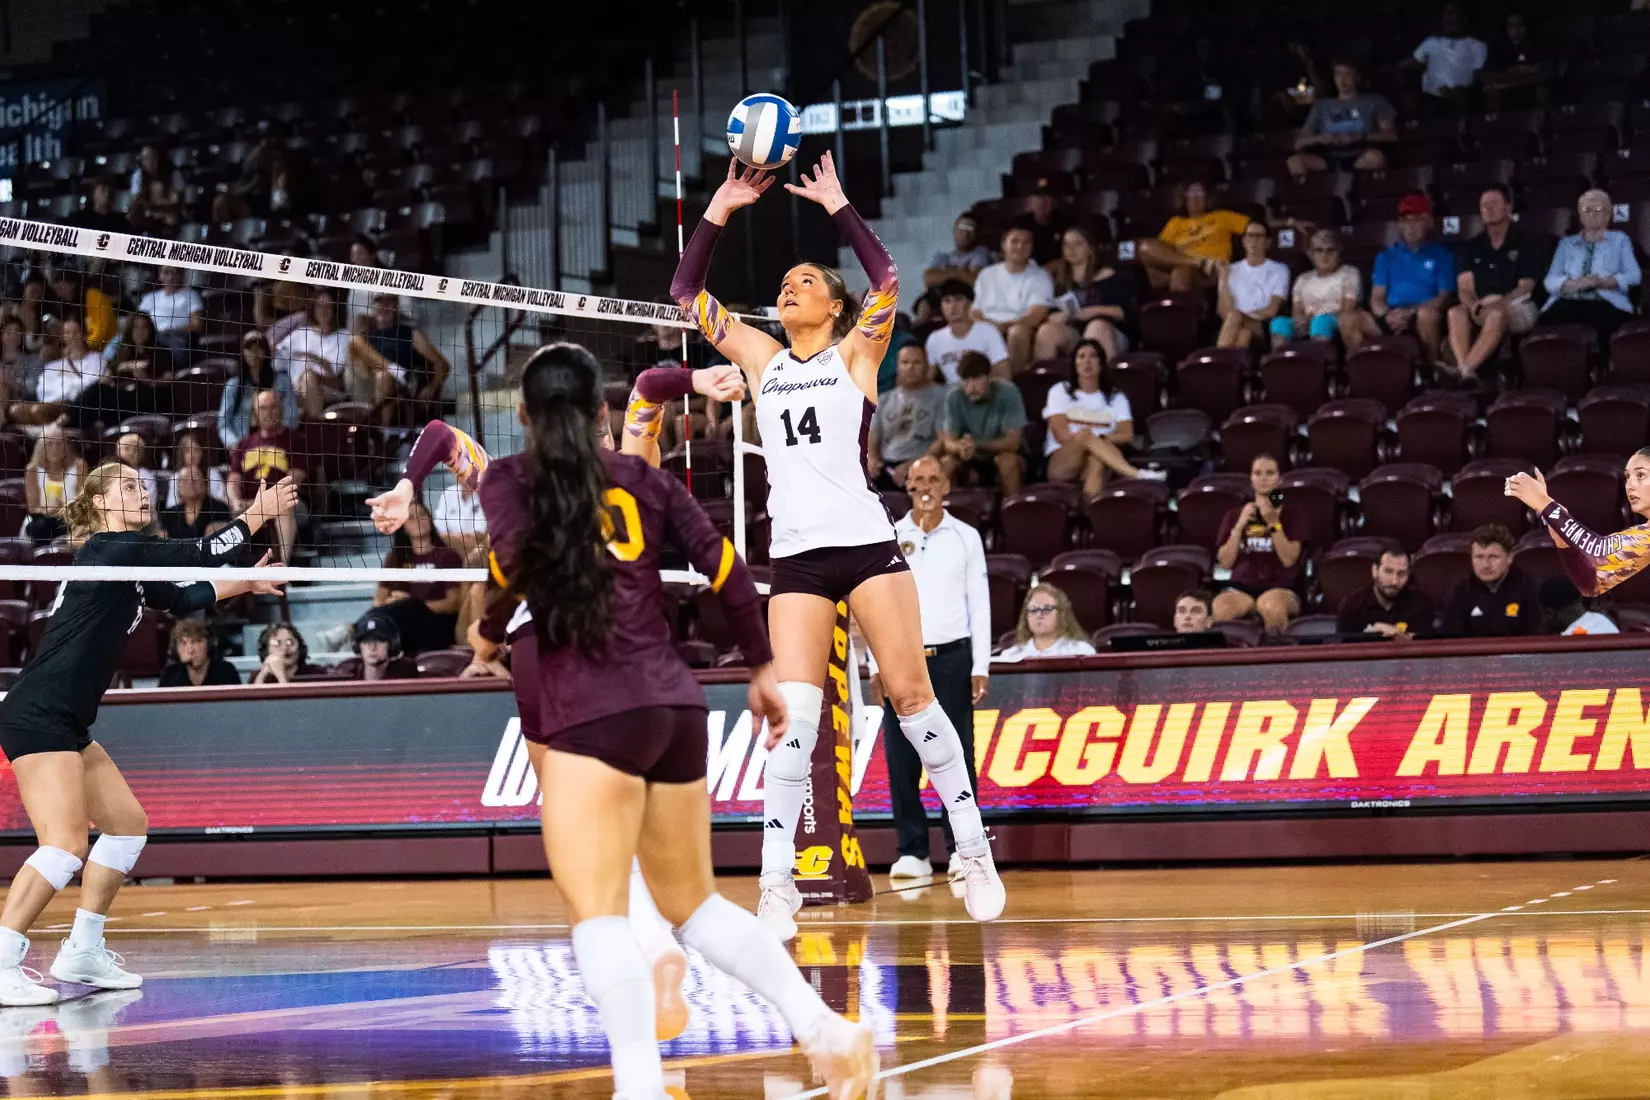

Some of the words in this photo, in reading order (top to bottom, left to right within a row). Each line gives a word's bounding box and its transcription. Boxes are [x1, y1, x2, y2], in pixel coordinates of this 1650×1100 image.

[20, 222, 79, 247] VOLLEYBALL
[127, 237, 166, 257] CENTRAL
[168, 243, 212, 263] MICHIGAN
[212, 249, 263, 271] VOLLEYBALL
[305, 261, 339, 281] CENTRAL
[341, 266, 380, 285] MICHIGAN
[380, 270, 424, 291] VOLLEYBALL
[461, 281, 490, 299] CENTRAL
[492, 284, 526, 303] MICHIGAN
[526, 290, 564, 309] VOLLEYBALL
[597, 299, 624, 315] CENTRAL
[625, 301, 655, 318] MICHIGAN
[762, 377, 838, 395] Chippewas
[780, 406, 822, 447] 14
[595, 486, 645, 561] 0
[1560, 518, 1622, 557] CHIPPEWAS
[1395, 687, 1650, 777] AREN
[1351, 800, 1410, 808] DAKTRONICS
